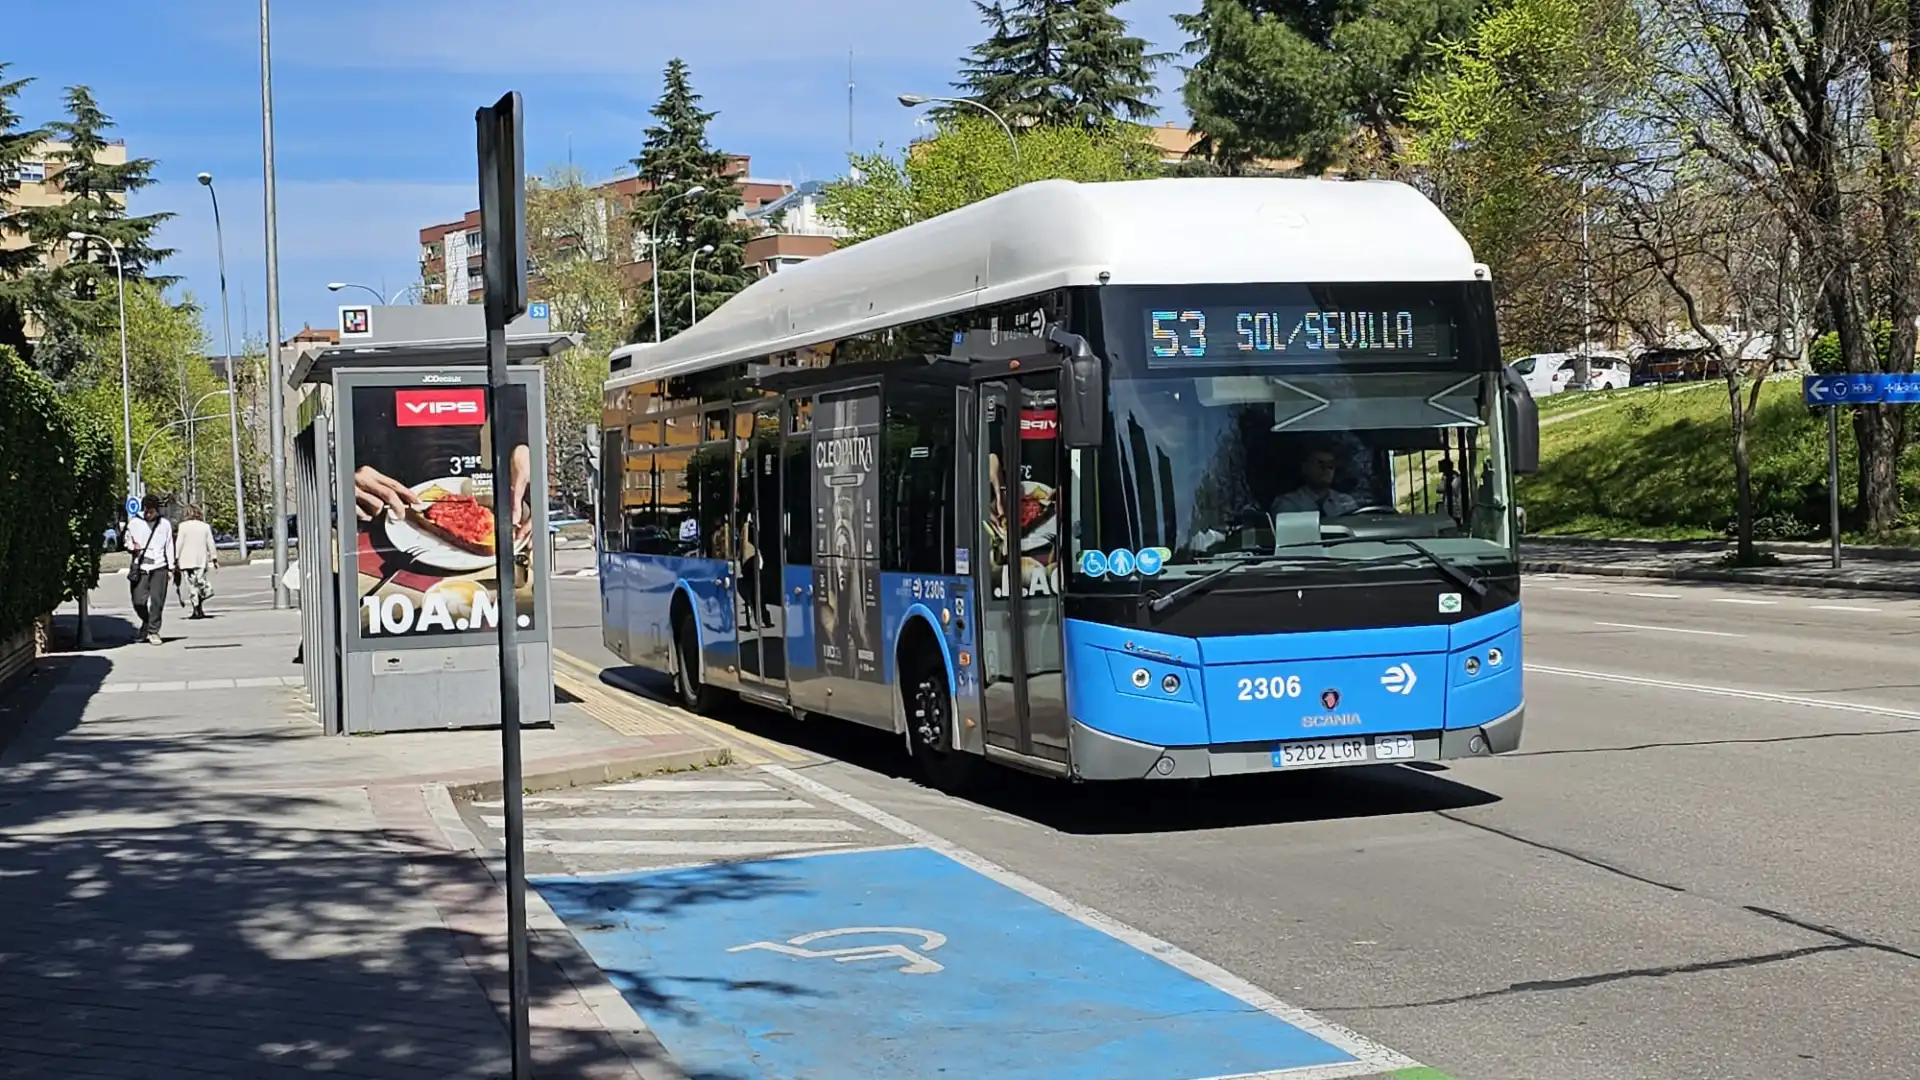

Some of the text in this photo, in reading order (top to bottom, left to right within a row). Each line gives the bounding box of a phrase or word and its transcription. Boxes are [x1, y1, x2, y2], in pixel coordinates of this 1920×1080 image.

[533, 306, 545, 317] 53
[1151, 310, 1413, 357] 53 SOL/SEVILLA
[404, 401, 478, 414] VIPS
[816, 434, 873, 472] CLEOPATRA
[924, 580, 945, 600] 2306
[1238, 675, 1301, 701] 2306
[1302, 713, 1361, 728] SCANIA
[1284, 743, 1326, 762] 5202
[1332, 740, 1362, 759] LGR
[1381, 737, 1408, 755] SP
